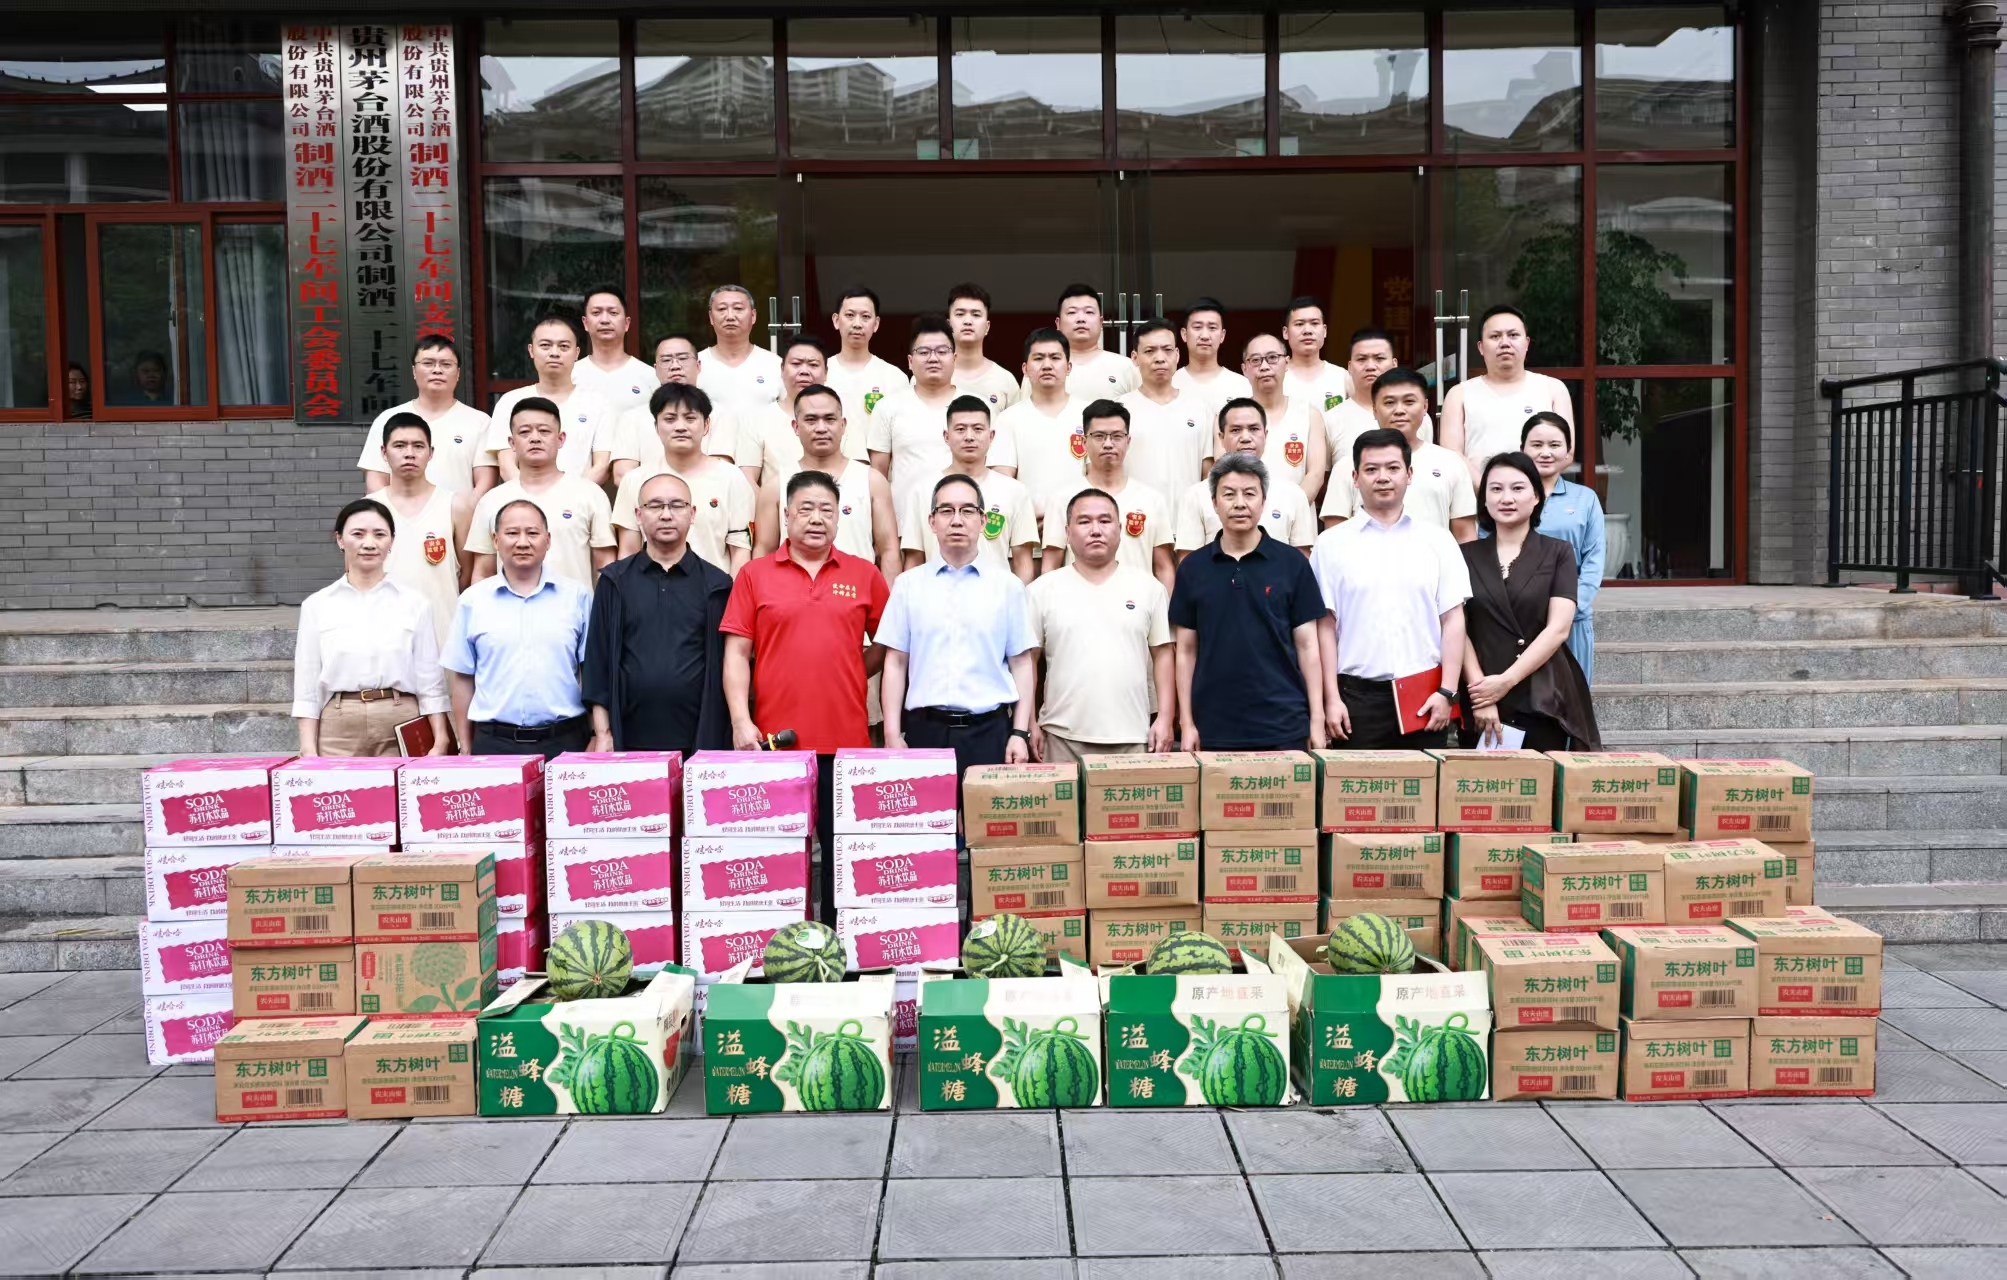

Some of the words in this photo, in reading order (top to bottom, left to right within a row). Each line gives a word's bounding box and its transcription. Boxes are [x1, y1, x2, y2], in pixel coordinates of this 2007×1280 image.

[286, 25, 310, 138] 股份有限公司
[312, 26, 337, 138] 中共贵州茅台酒
[401, 25, 425, 138] 股份有限公司
[427, 26, 452, 138] 中共贵州茅台酒
[295, 141, 342, 417] 制酒二十七车间工会委员会
[874, 781, 913, 796] SODA
[1230, 775, 1287, 791] 东方树叶
[1341, 778, 1398, 794] 东方树叶
[1457, 778, 1514, 794] 东方树叶
[1592, 778, 1649, 794] 东方树叶
[312, 793, 351, 808] SODA
[442, 791, 481, 806] SODA
[588, 786, 627, 801] SODA
[596, 795, 623, 805] DRINK
[728, 785, 767, 800] SODA
[736, 794, 763, 804] DRINK
[882, 790, 909, 800] DRINK
[1103, 786, 1160, 802] 东方树叶
[1725, 787, 1785, 804] 东方树叶
[185, 794, 224, 809] SODA
[193, 803, 220, 813] DRINK
[320, 802, 347, 812] DRINK
[450, 800, 477, 810] DRINK
[591, 800, 632, 816] 苏打水饮品
[731, 798, 772, 816] 苏打水饮品
[877, 794, 918, 812] 苏打水饮品
[991, 795, 1048, 811] 东方树叶
[188, 808, 230, 824] 苏打水饮品
[315, 806, 356, 824] 苏打水饮品
[445, 804, 486, 822] 苏打水饮品
[1113, 854, 1170, 870] 东方树叶
[1221, 848, 1278, 864] 东方树叶
[1360, 846, 1417, 862] 东方树叶
[589, 860, 628, 875] SODA
[725, 860, 764, 875] SODA
[874, 857, 913, 872] SODA
[882, 866, 909, 876] DRINK
[190, 868, 228, 883] SODA
[198, 877, 225, 887] DRINK
[592, 874, 634, 890] 苏打水饮品
[597, 869, 624, 879] DRINK
[728, 874, 770, 890] 苏打水饮品
[733, 869, 760, 879] DRINK
[877, 870, 918, 888] 苏打水饮品
[988, 866, 1045, 882] 东方树叶
[1696, 873, 1756, 890] 东方树叶
[193, 884, 227, 899] 苏打水饮
[372, 883, 435, 900] 东方树叶
[1562, 875, 1622, 892] 东方树叶
[245, 887, 308, 904] 东方树叶
[1107, 922, 1164, 938] 东方树叶
[1221, 921, 1278, 937] 东方树叶
[725, 934, 764, 949] SODA
[880, 931, 919, 946] SODA
[888, 940, 915, 950] DRINK
[185, 942, 224, 957] SODA
[193, 951, 220, 961] DRINK
[733, 943, 760, 953] DRINK
[883, 944, 924, 962] 苏打水饮品
[188, 956, 230, 972] 苏打水饮品
[1665, 960, 1728, 978] 东方树叶
[1774, 955, 1837, 972] 东方树叶
[250, 964, 313, 982] 东方树叶
[1191, 985, 1264, 1001] 原产地直采
[1395, 985, 1466, 1001] 原产地直采
[1525, 976, 1588, 994] 东方树叶
[186, 1015, 225, 1030] SODA
[194, 1024, 221, 1034] DRINK
[1525, 1045, 1588, 1062] 东方树叶
[1645, 1040, 1708, 1058] 东方树叶
[1770, 1037, 1833, 1054] 东方树叶
[235, 1060, 301, 1078] 东方树叶
[375, 1056, 441, 1074] 东方树叶
